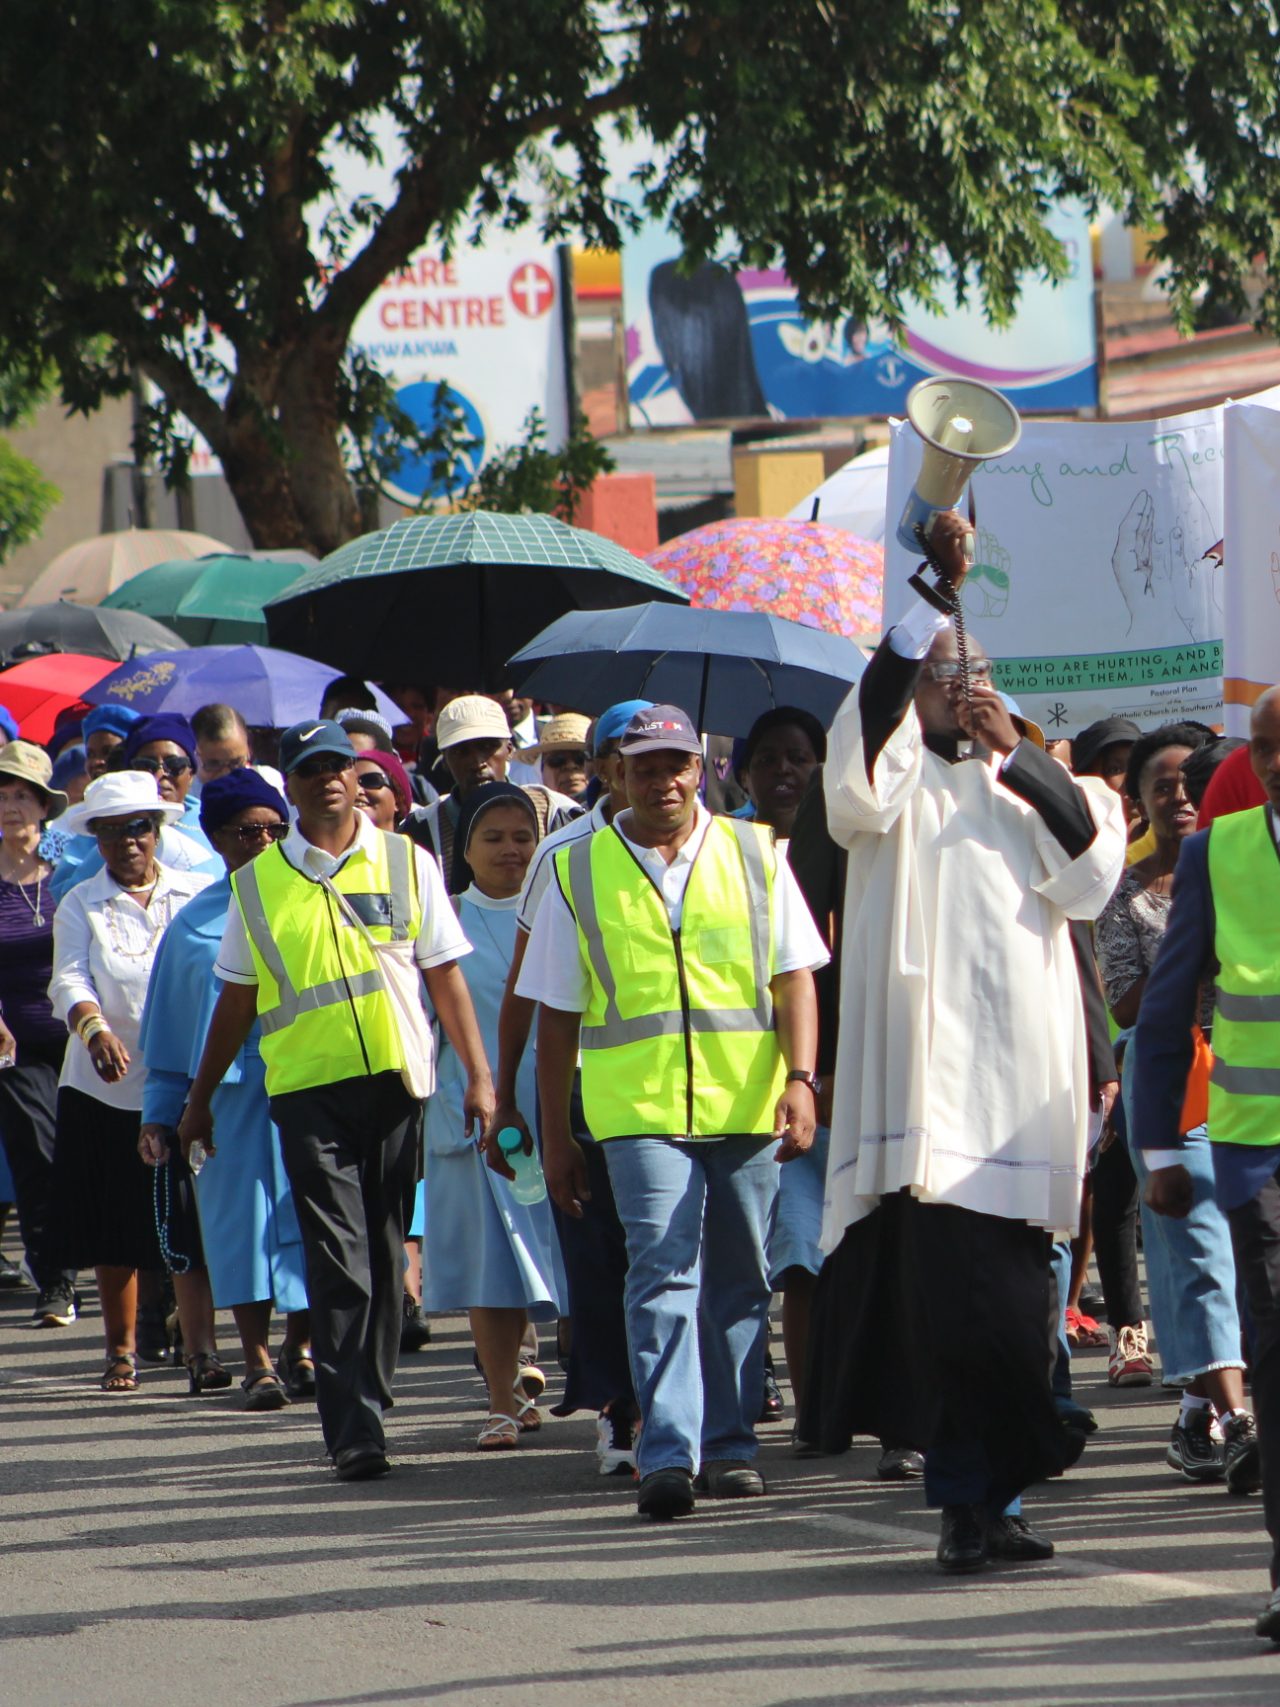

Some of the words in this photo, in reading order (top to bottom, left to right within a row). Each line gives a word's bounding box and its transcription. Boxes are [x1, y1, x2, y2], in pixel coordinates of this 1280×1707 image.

[380, 297, 505, 330] CENTRE
[1060, 443, 1138, 477] and
[990, 664, 1012, 675] SE
[1019, 662, 1055, 673] WHO
[1063, 660, 1089, 672] ARE
[1097, 654, 1168, 669] HURTING,
[1176, 649, 1206, 662] AND
[1002, 676, 1038, 688] WHO
[1046, 674, 1082, 686] HURT
[1089, 671, 1134, 683] THEM,
[1142, 668, 1154, 679] IS
[1162, 665, 1181, 677] AN
[1189, 658, 1223, 674] ANCI
[1150, 687, 1180, 697] Pastoral
[1182, 685, 1198, 694] Plan
[1143, 708, 1170, 717] Church
[1171, 706, 1178, 714] in
[1180, 703, 1213, 713] Southern
